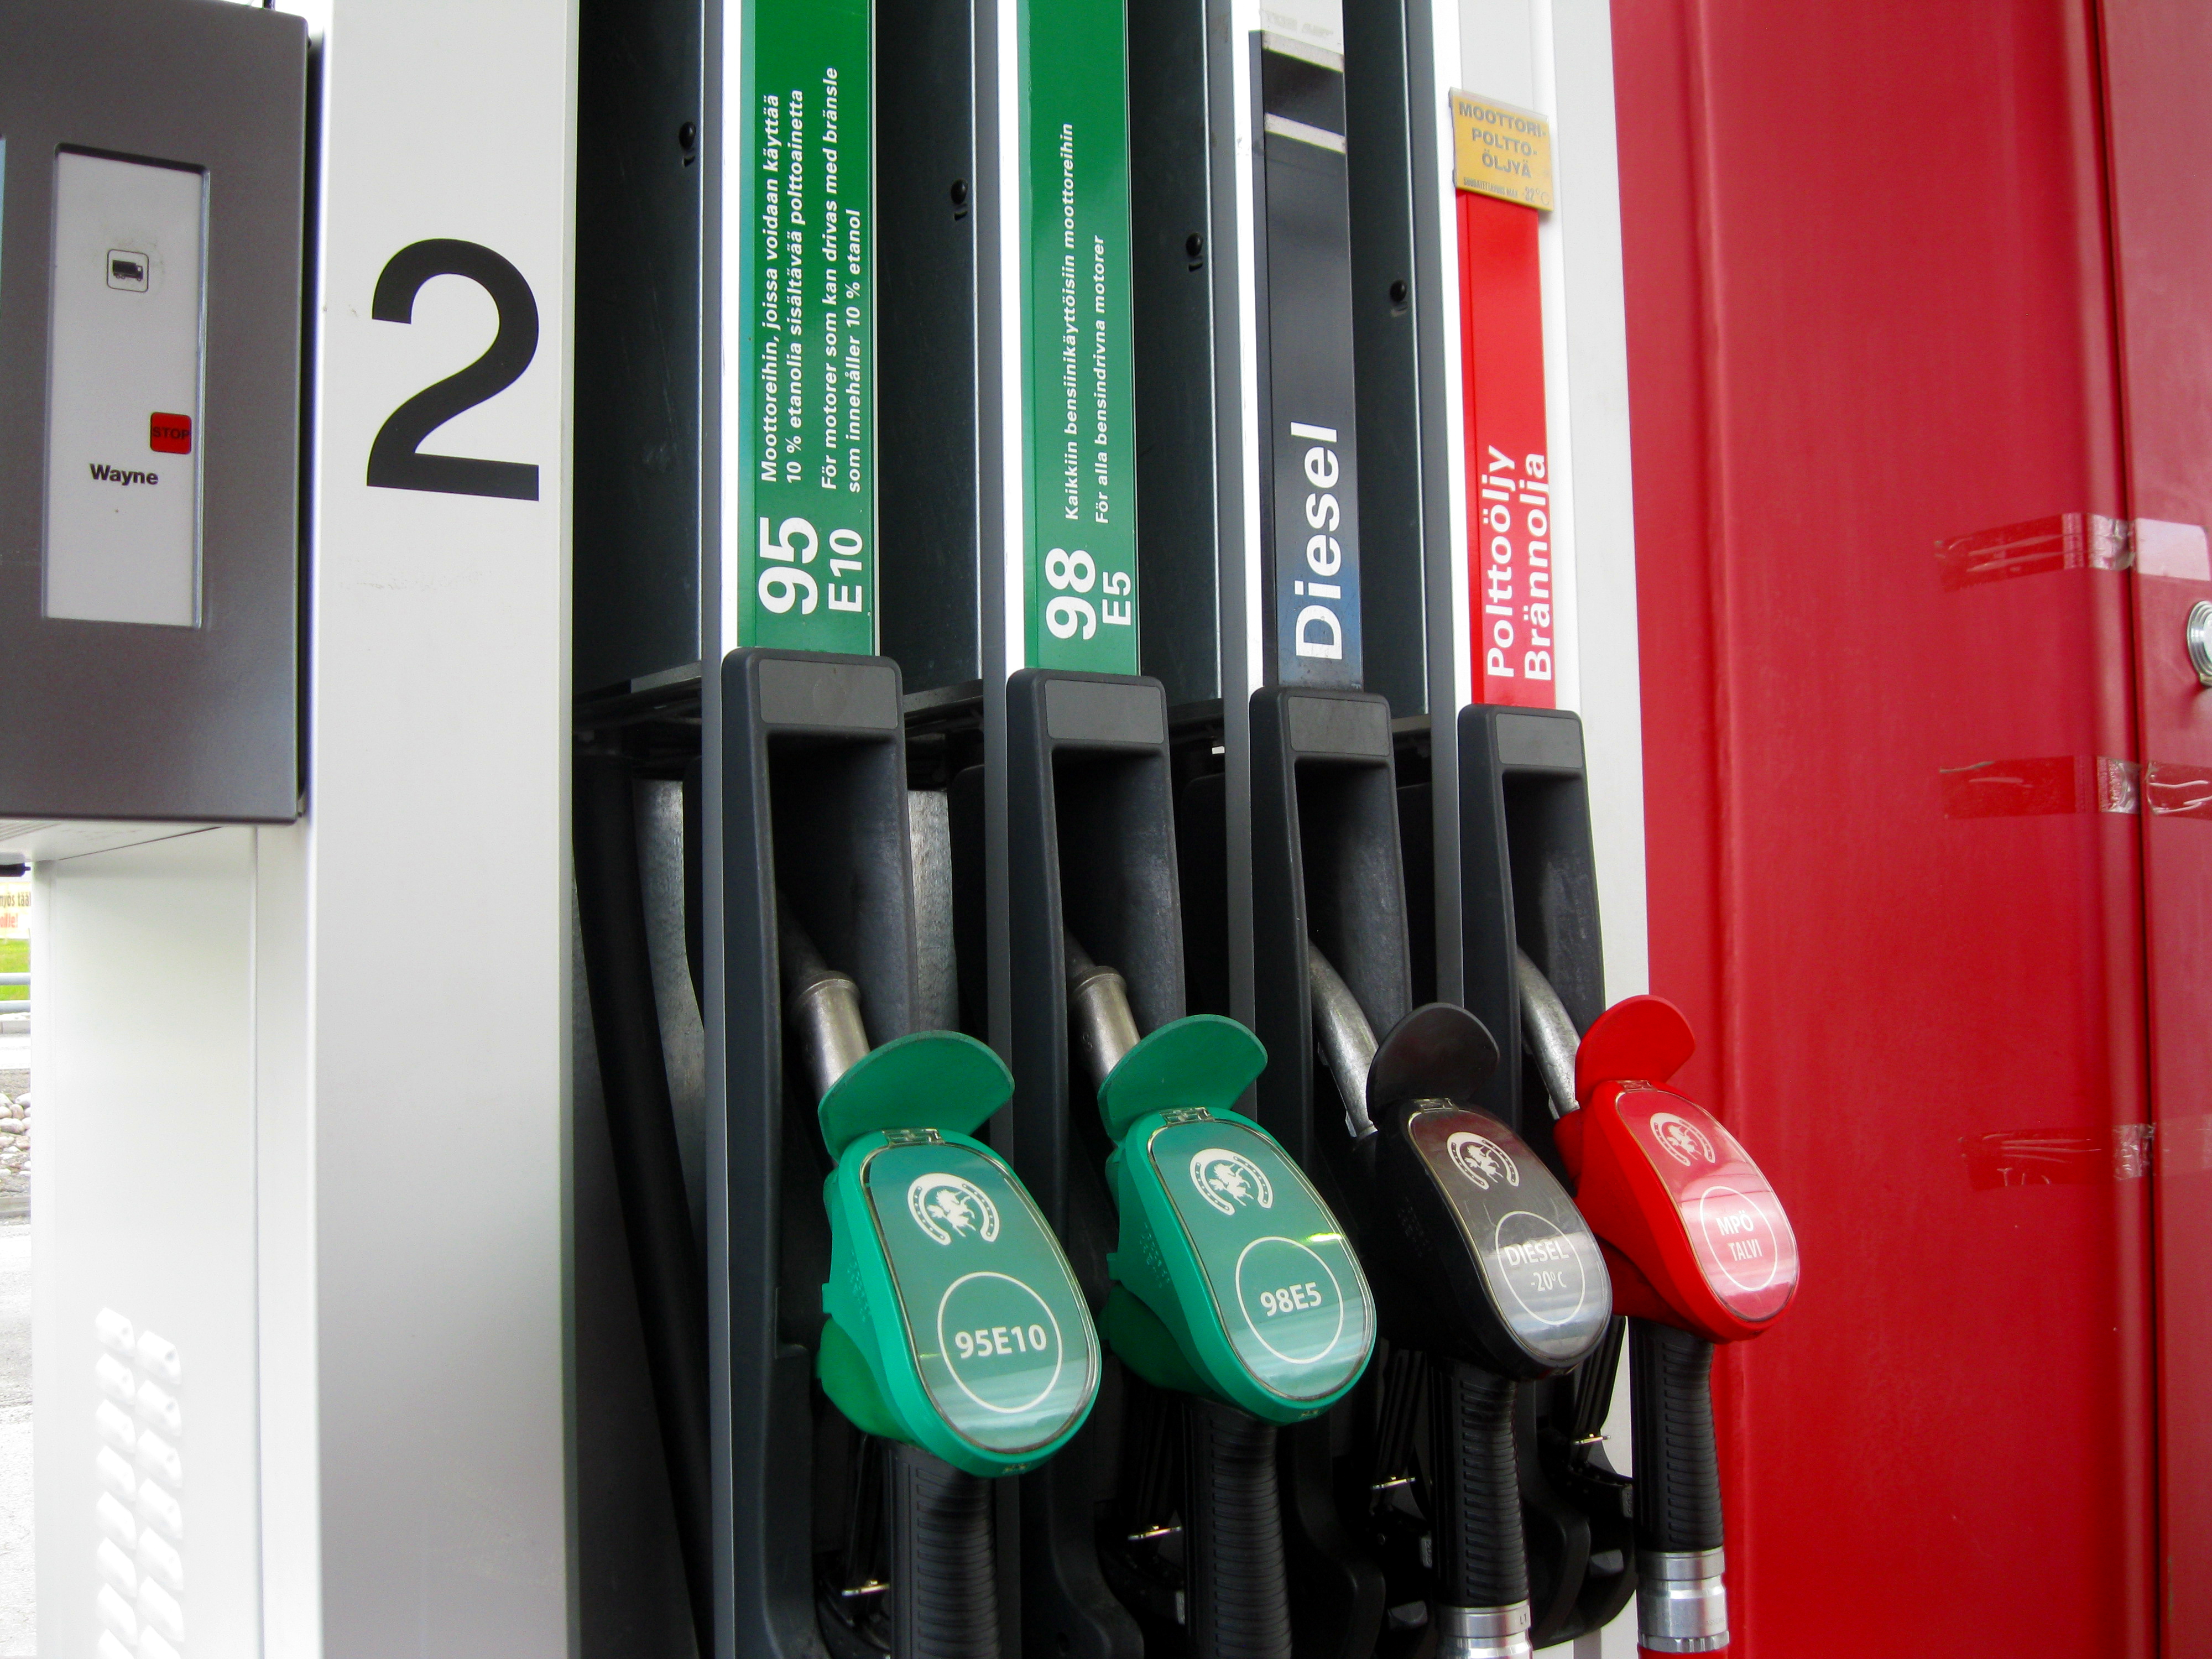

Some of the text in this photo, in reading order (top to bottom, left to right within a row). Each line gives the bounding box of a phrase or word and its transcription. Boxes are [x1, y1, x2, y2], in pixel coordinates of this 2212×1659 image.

[1459, 101, 1547, 137] MOOTTORI-
[1472, 127, 1538, 156] POLTTO-
[1481, 148, 1532, 178] ÖLJYÄ
[761, 95, 781, 482] Moottoreihin, joissa voidaan käyttää
[785, 91, 805, 483] 10 % etanolia sisältävää polttoainetta
[822, 68, 837, 489] För motorer som kan drivas med bränsle
[1060, 124, 1078, 519] Kaikkiin bensiinikäyttöisiin moottoreihin
[367, 239, 539, 500] 2
[845, 210, 860, 493] som innehåller 10 % etanol
[1093, 236, 1108, 523] För alla bensindrivna motorer
[90, 463, 159, 486] Wayne
[153, 426, 190, 440] STOP
[759, 517, 818, 614] 95
[828, 529, 862, 612] E10
[1291, 422, 1342, 659] Diesel
[1481, 446, 1516, 677] Polttoöljy
[1519, 453, 1552, 681] Brännolja
[1045, 549, 1096, 639] 98
[1103, 572, 1131, 625] E5
[1504, 1240, 1569, 1266] DIESEL
[1716, 1209, 1754, 1236] MPÖ
[1727, 1238, 1763, 1261] TALVI
[955, 1325, 1046, 1358] 95E10
[1261, 1282, 1321, 1316] 98E5
